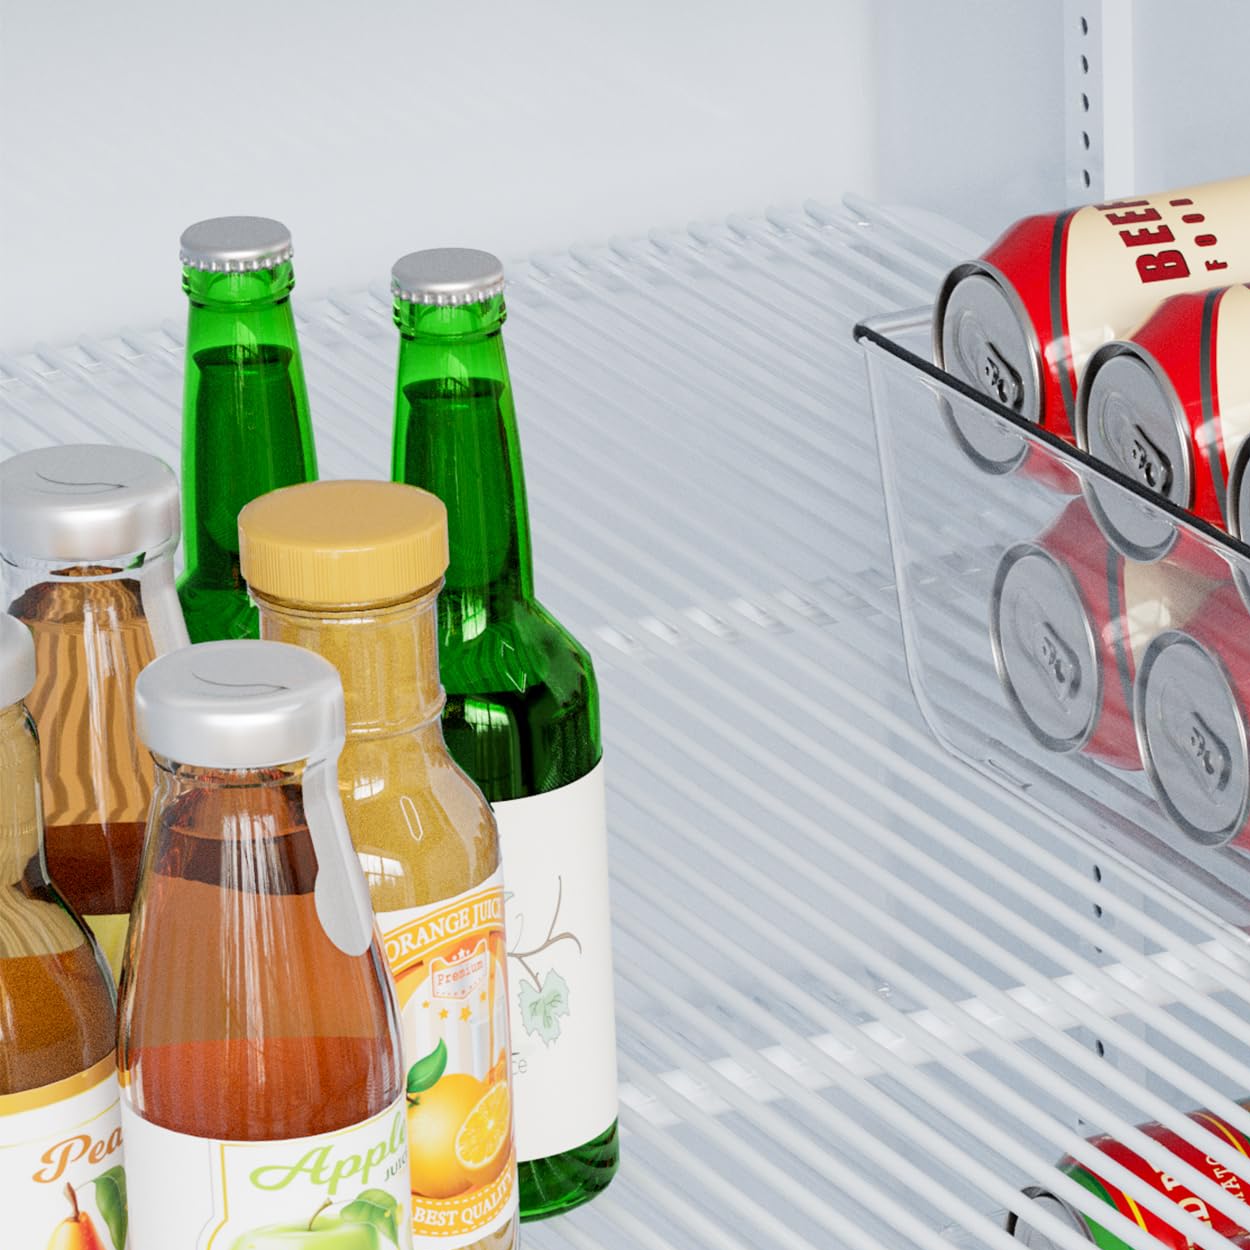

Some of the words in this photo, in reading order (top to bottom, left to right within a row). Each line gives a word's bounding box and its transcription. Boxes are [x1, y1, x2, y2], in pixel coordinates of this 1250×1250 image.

[385, 907, 470, 963] ORANGE
[472, 897, 503, 929] JUIC
[437, 959, 484, 986] Premium
[31, 1126, 123, 1183] Pea
[414, 1205, 459, 1227] BEST
